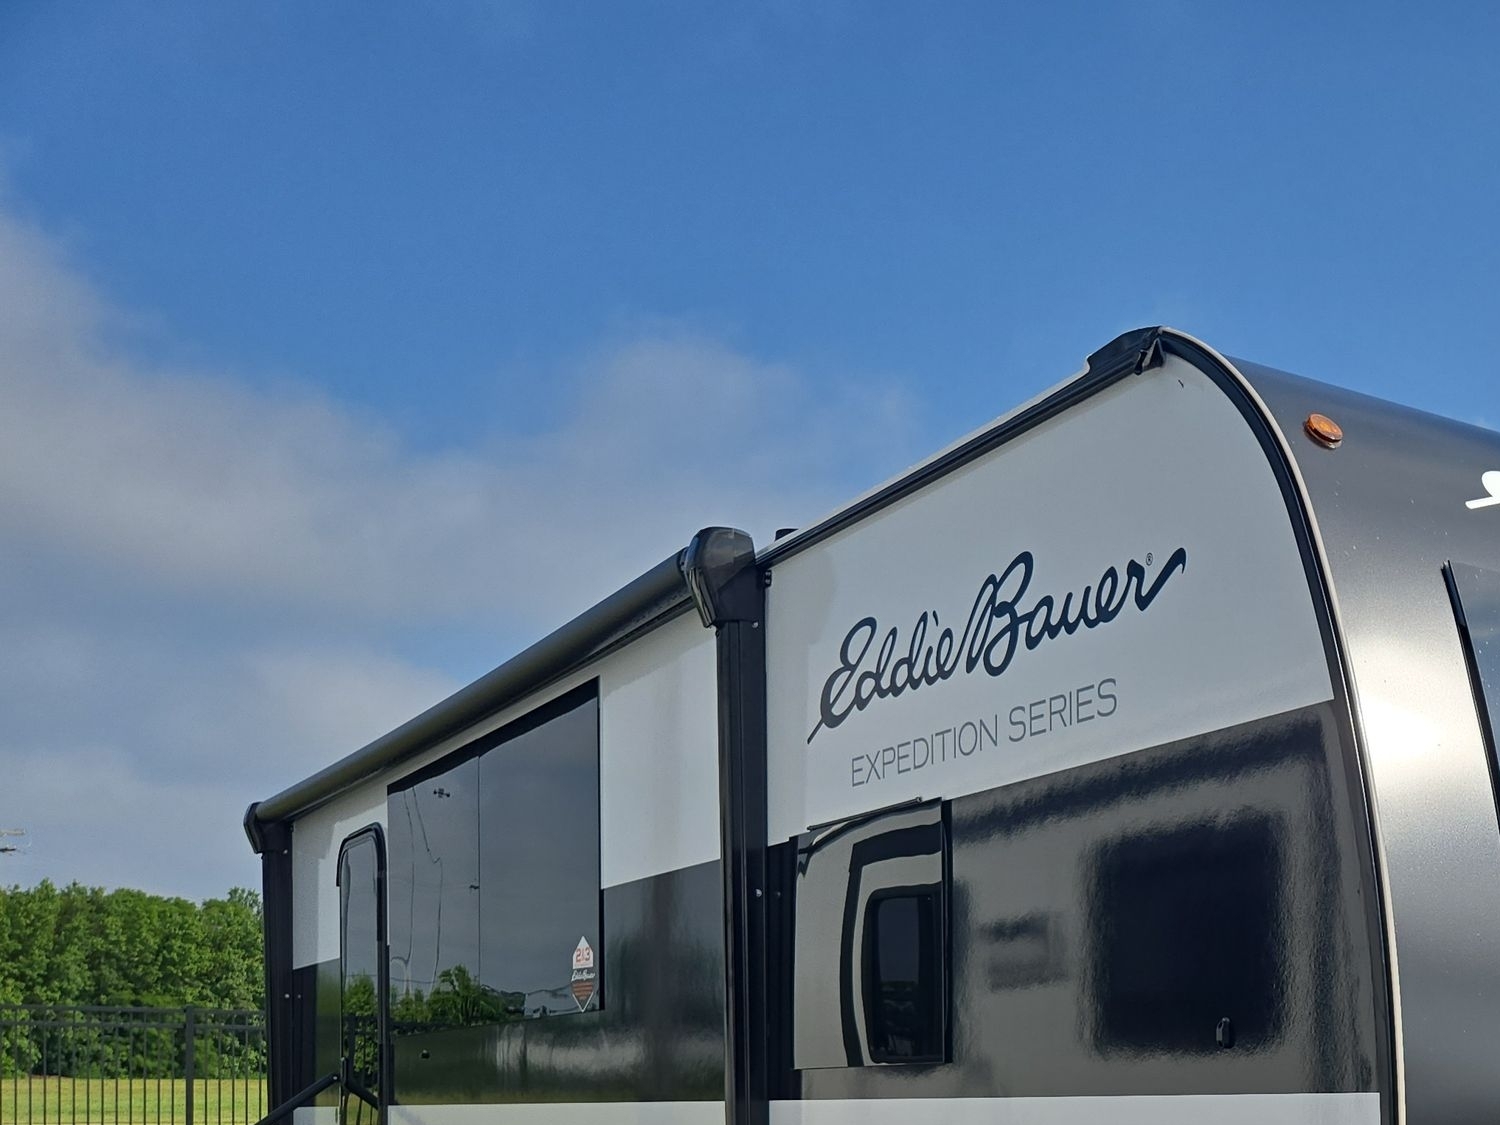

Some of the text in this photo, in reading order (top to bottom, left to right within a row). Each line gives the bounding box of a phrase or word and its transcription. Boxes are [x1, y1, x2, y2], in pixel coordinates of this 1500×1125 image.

[807, 547, 1188, 745] Eddie Bauer
[851, 677, 1118, 787] EXPEDITION SERIES
